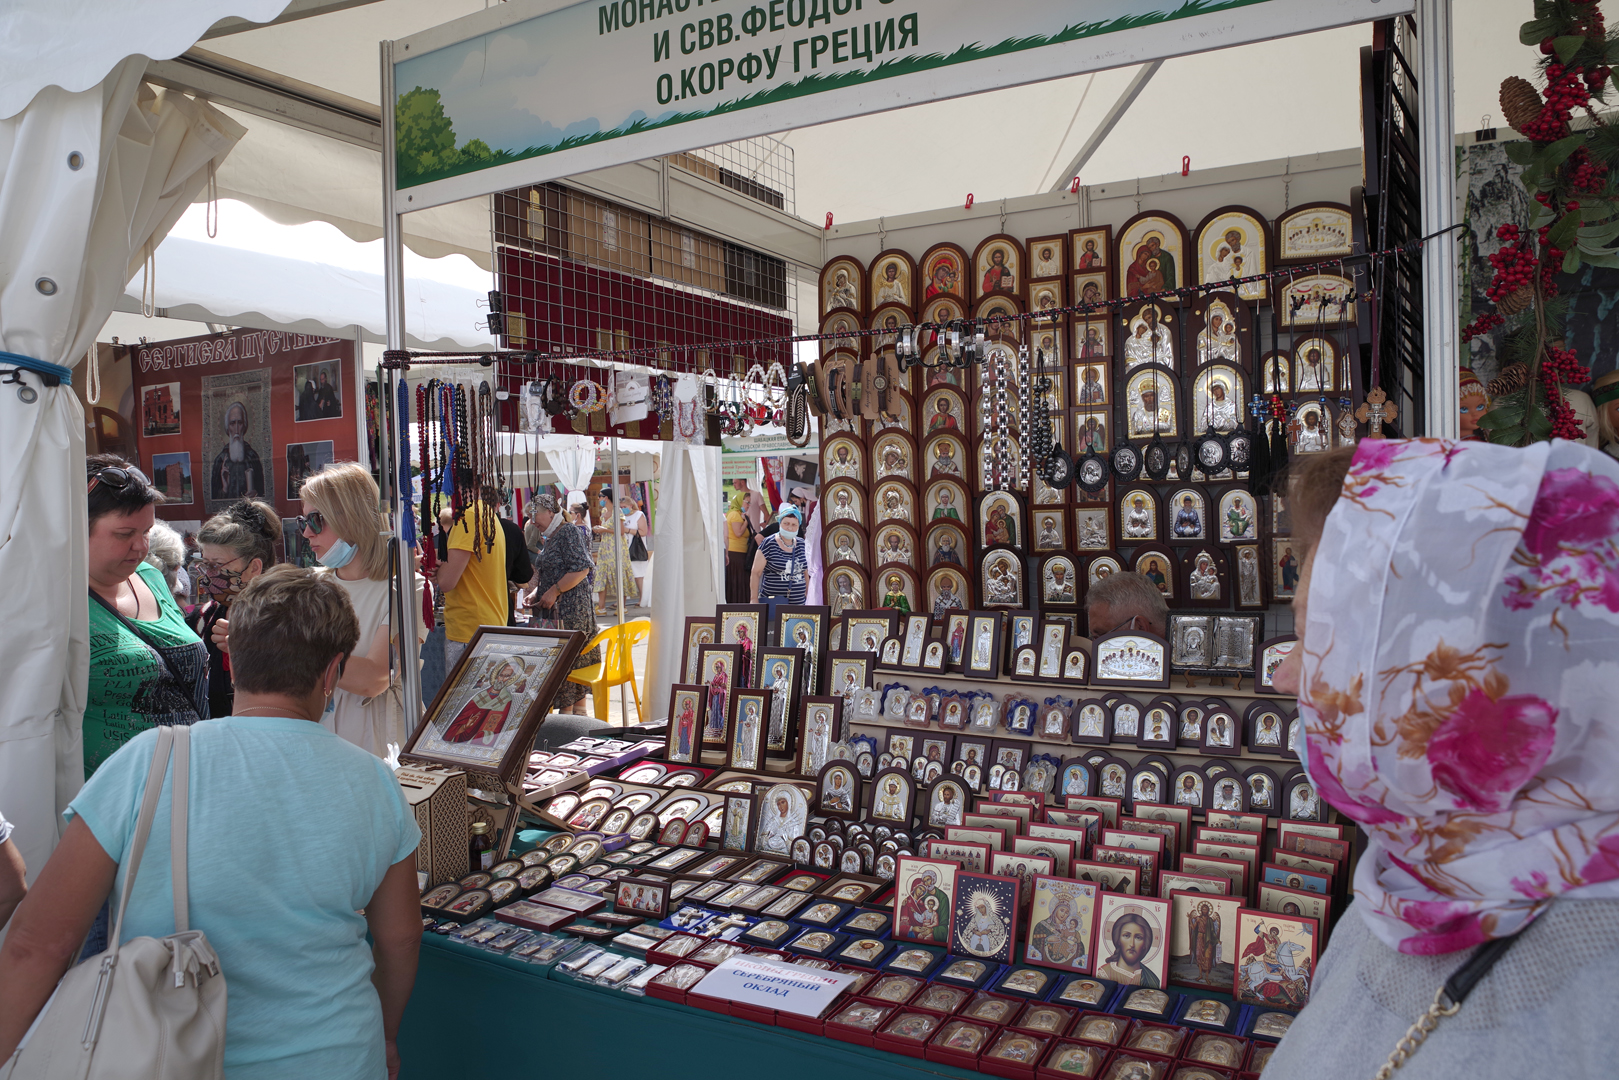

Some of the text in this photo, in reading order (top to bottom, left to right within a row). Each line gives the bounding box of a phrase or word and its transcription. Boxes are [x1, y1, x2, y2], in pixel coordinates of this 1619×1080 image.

[653, 29, 670, 63] И
[656, 12, 918, 105] О.КОРФУ ГРЕЦИЯ
[241, 330, 341, 363] ПУСТЫ
[762, 441, 793, 449] ПРАВОСЛАВНО
[734, 960, 782, 975] ИКОНЫ
[732, 969, 821, 991] СЕРЕБРЯНЫЙ
[743, 982, 790, 997] ОКЛАД
